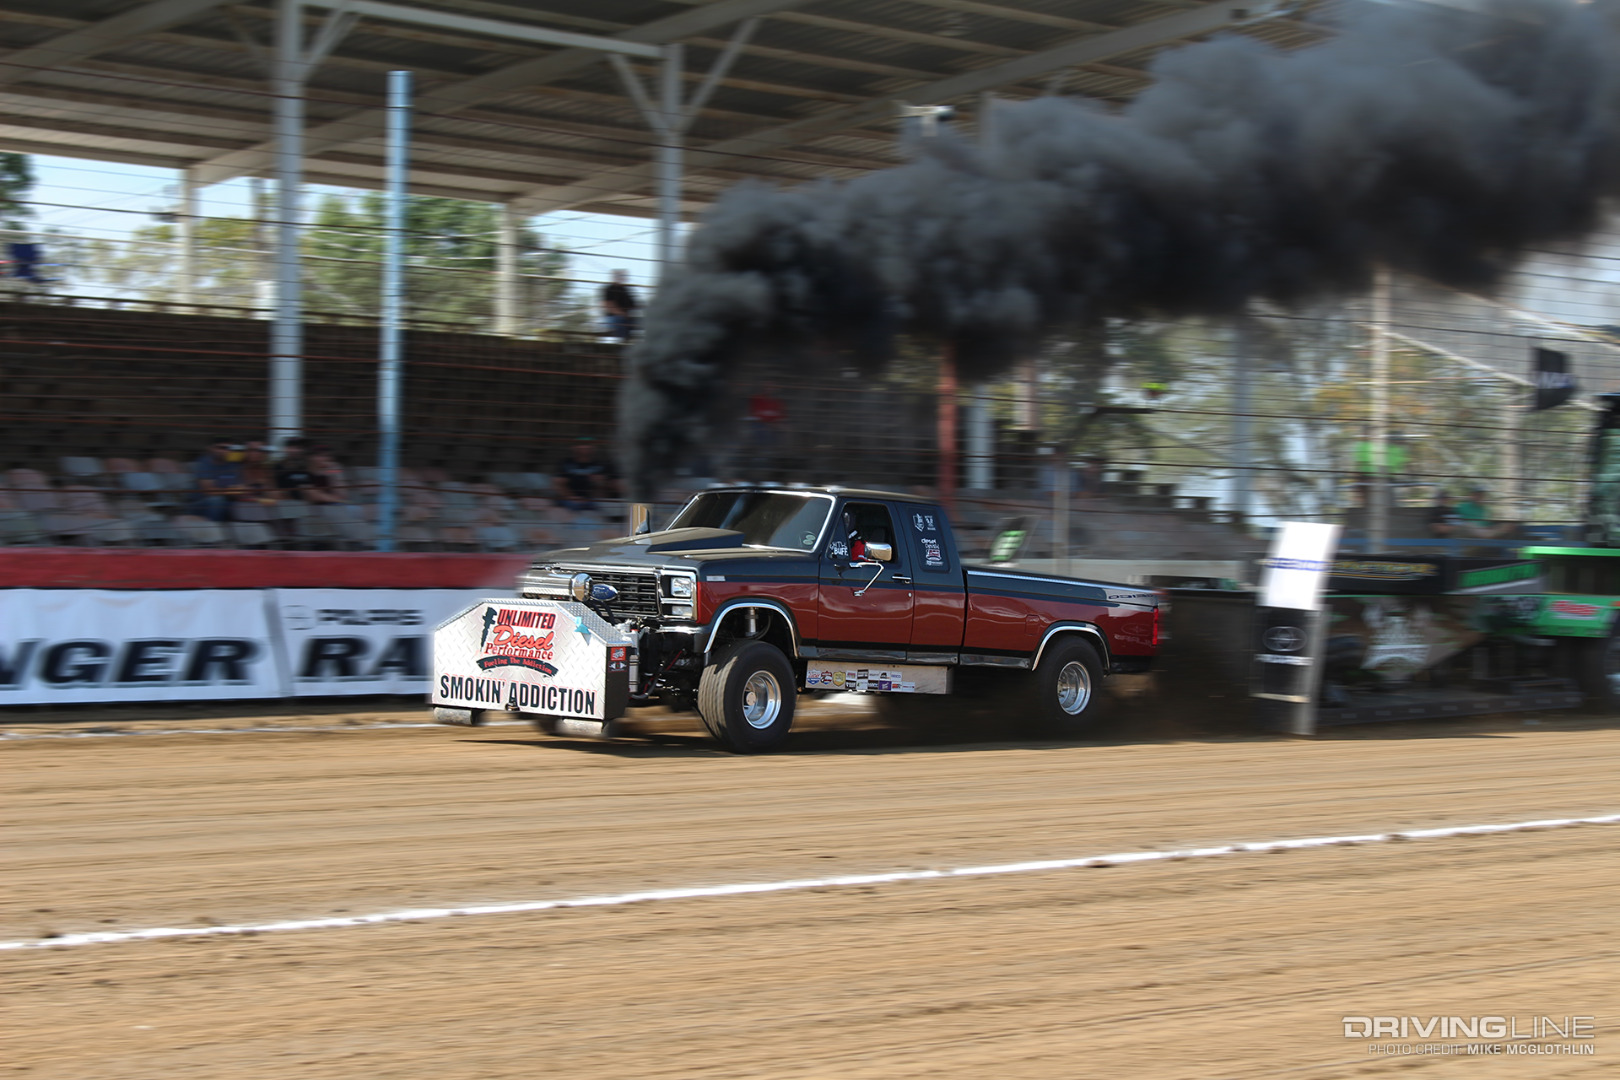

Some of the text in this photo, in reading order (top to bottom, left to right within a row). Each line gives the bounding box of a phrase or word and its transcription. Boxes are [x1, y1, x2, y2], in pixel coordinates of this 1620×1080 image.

[497, 609, 557, 630] UNLIMITED
[493, 624, 554, 651] Diesel
[484, 642, 554, 661] Performance
[484, 656, 553, 675] Fueling The Addiction
[440, 675, 596, 716] SMOKIN' ADDICTION
